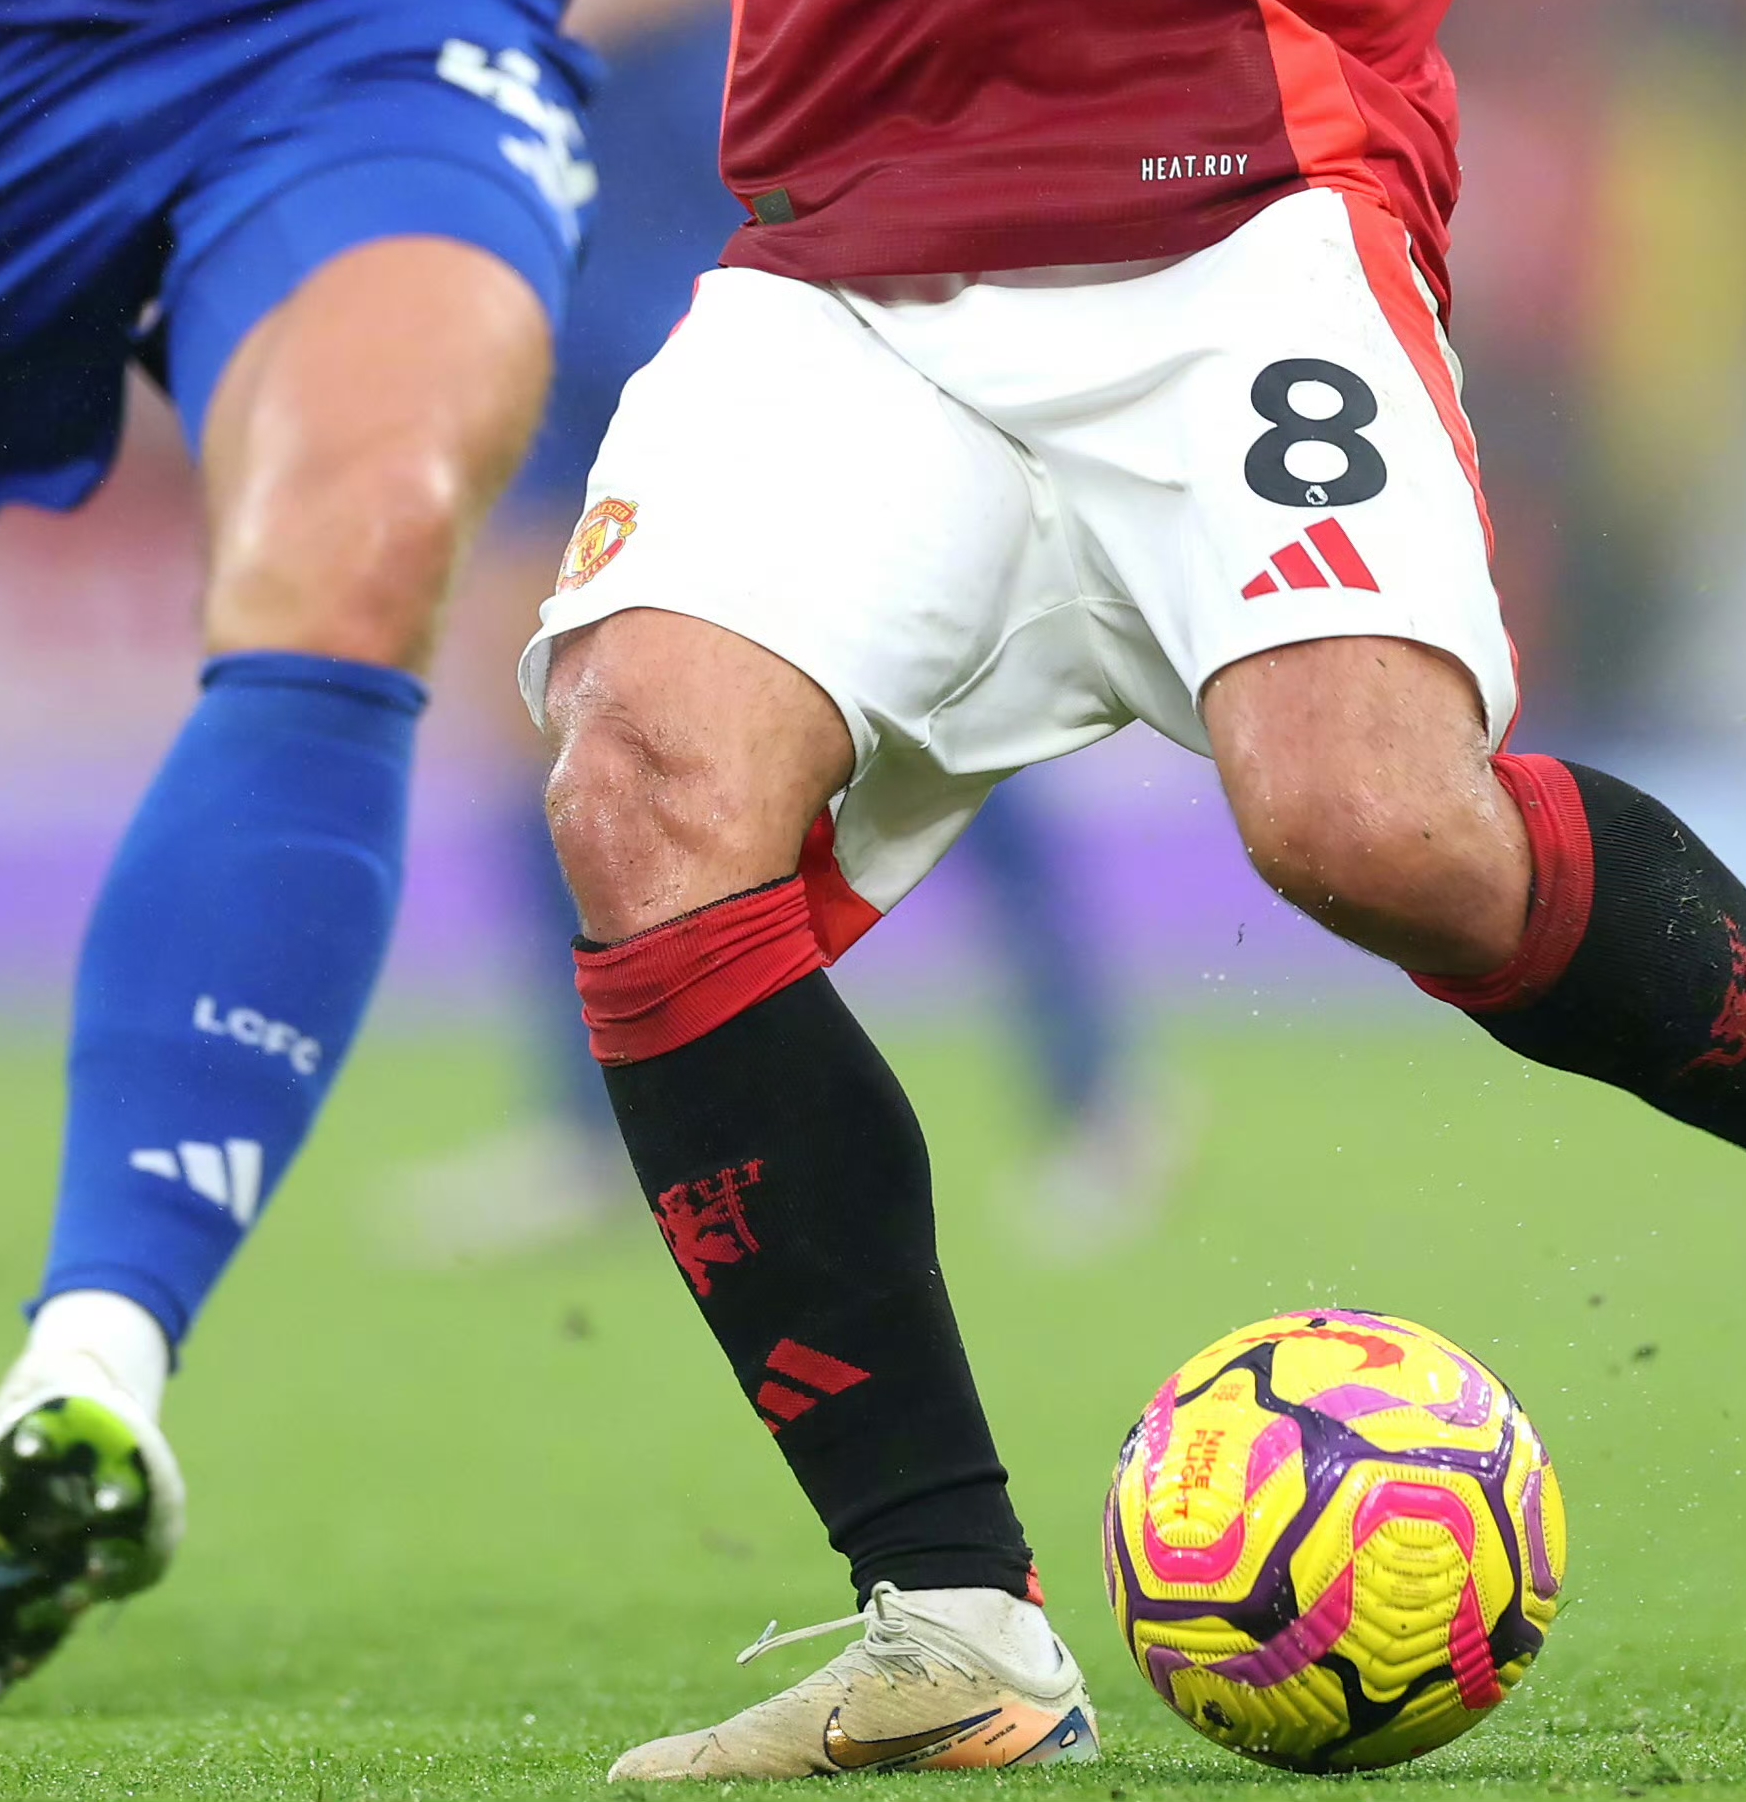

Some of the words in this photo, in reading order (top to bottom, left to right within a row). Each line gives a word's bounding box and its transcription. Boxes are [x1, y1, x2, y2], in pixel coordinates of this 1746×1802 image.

[1140, 153, 1249, 182] HEAT.RDY
[1244, 358, 1388, 508] 8
[193, 994, 323, 1076] LCFC
[1173, 1429, 1208, 1520] FLIGHT
[1194, 1429, 1226, 1490] NIKE
